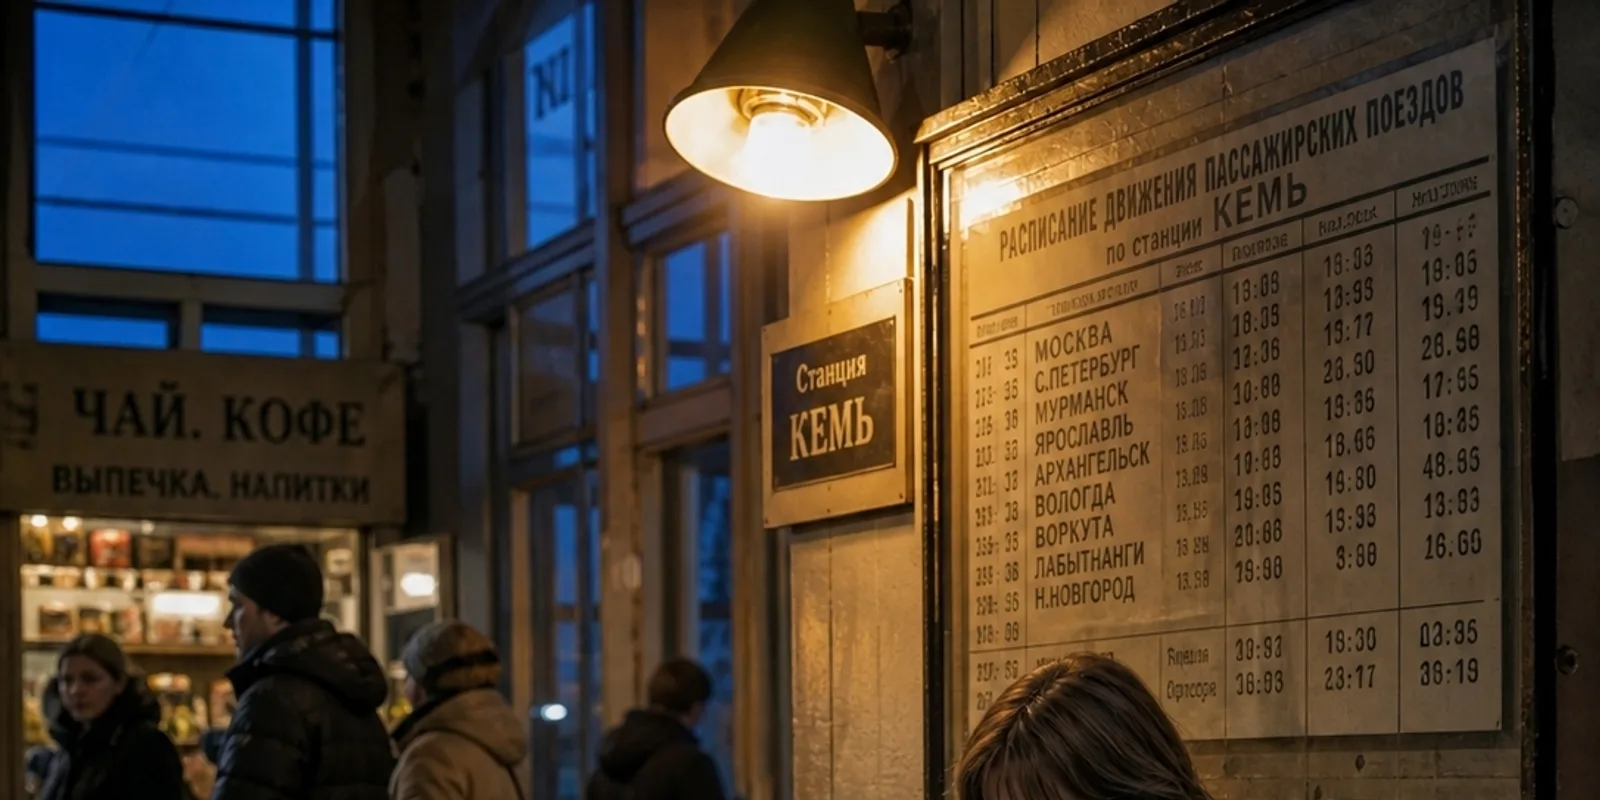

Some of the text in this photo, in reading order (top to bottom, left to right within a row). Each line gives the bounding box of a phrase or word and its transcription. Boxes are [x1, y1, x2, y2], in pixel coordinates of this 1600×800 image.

[999, 197, 1097, 262] РАСПИСАНИЕ
[1104, 162, 1196, 233] ДВИЖЕНИЯ
[1205, 105, 1358, 193] ПАССАЖИРСКИХ
[1366, 69, 1464, 139] ПОЕЗДОВ
[1106, 241, 1125, 266] по
[1132, 217, 1203, 257] станции
[1213, 172, 1308, 232] КЕМЬ
[1035, 320, 1113, 364] МОСКВА
[796, 353, 867, 393] Станция
[1035, 344, 1140, 394] С.ПЕТЕРБУРГ
[221, 396, 366, 447] КОФЕ
[1035, 379, 1129, 425] МУРМАНСК
[789, 396, 874, 461] КЕМЬ
[1035, 413, 1134, 457] ЯРОСЛАВЛЬ
[1035, 441, 1151, 487] АРХАНГЕЛЬСК
[230, 471, 371, 505] НАПИТКИ
[1035, 481, 1116, 518] ВОЛОГДА
[1035, 514, 1114, 549] ВОРКУТА
[1035, 541, 1144, 579] ЛАБЫТНАНГИ
[1035, 575, 1136, 610] Н.НОВГОРОД
